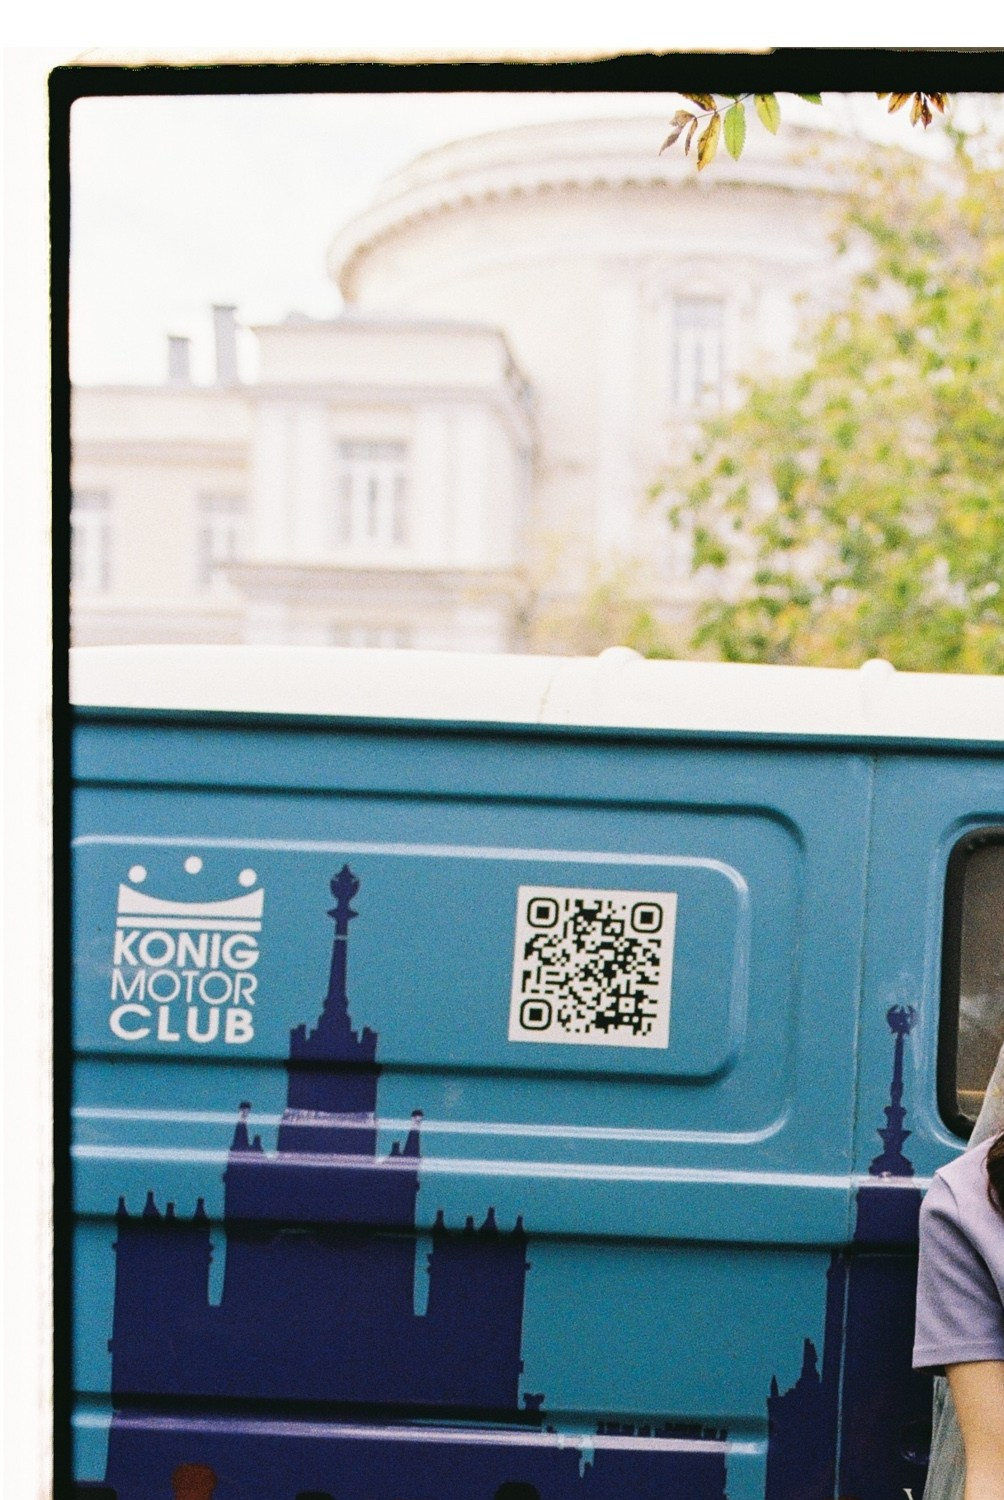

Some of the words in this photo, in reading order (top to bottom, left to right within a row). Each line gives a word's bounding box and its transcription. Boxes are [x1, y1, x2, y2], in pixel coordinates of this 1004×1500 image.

[114, 930, 260, 969] KONIG
[111, 969, 258, 1005] MOTOR
[109, 1004, 254, 1044] CLUB
